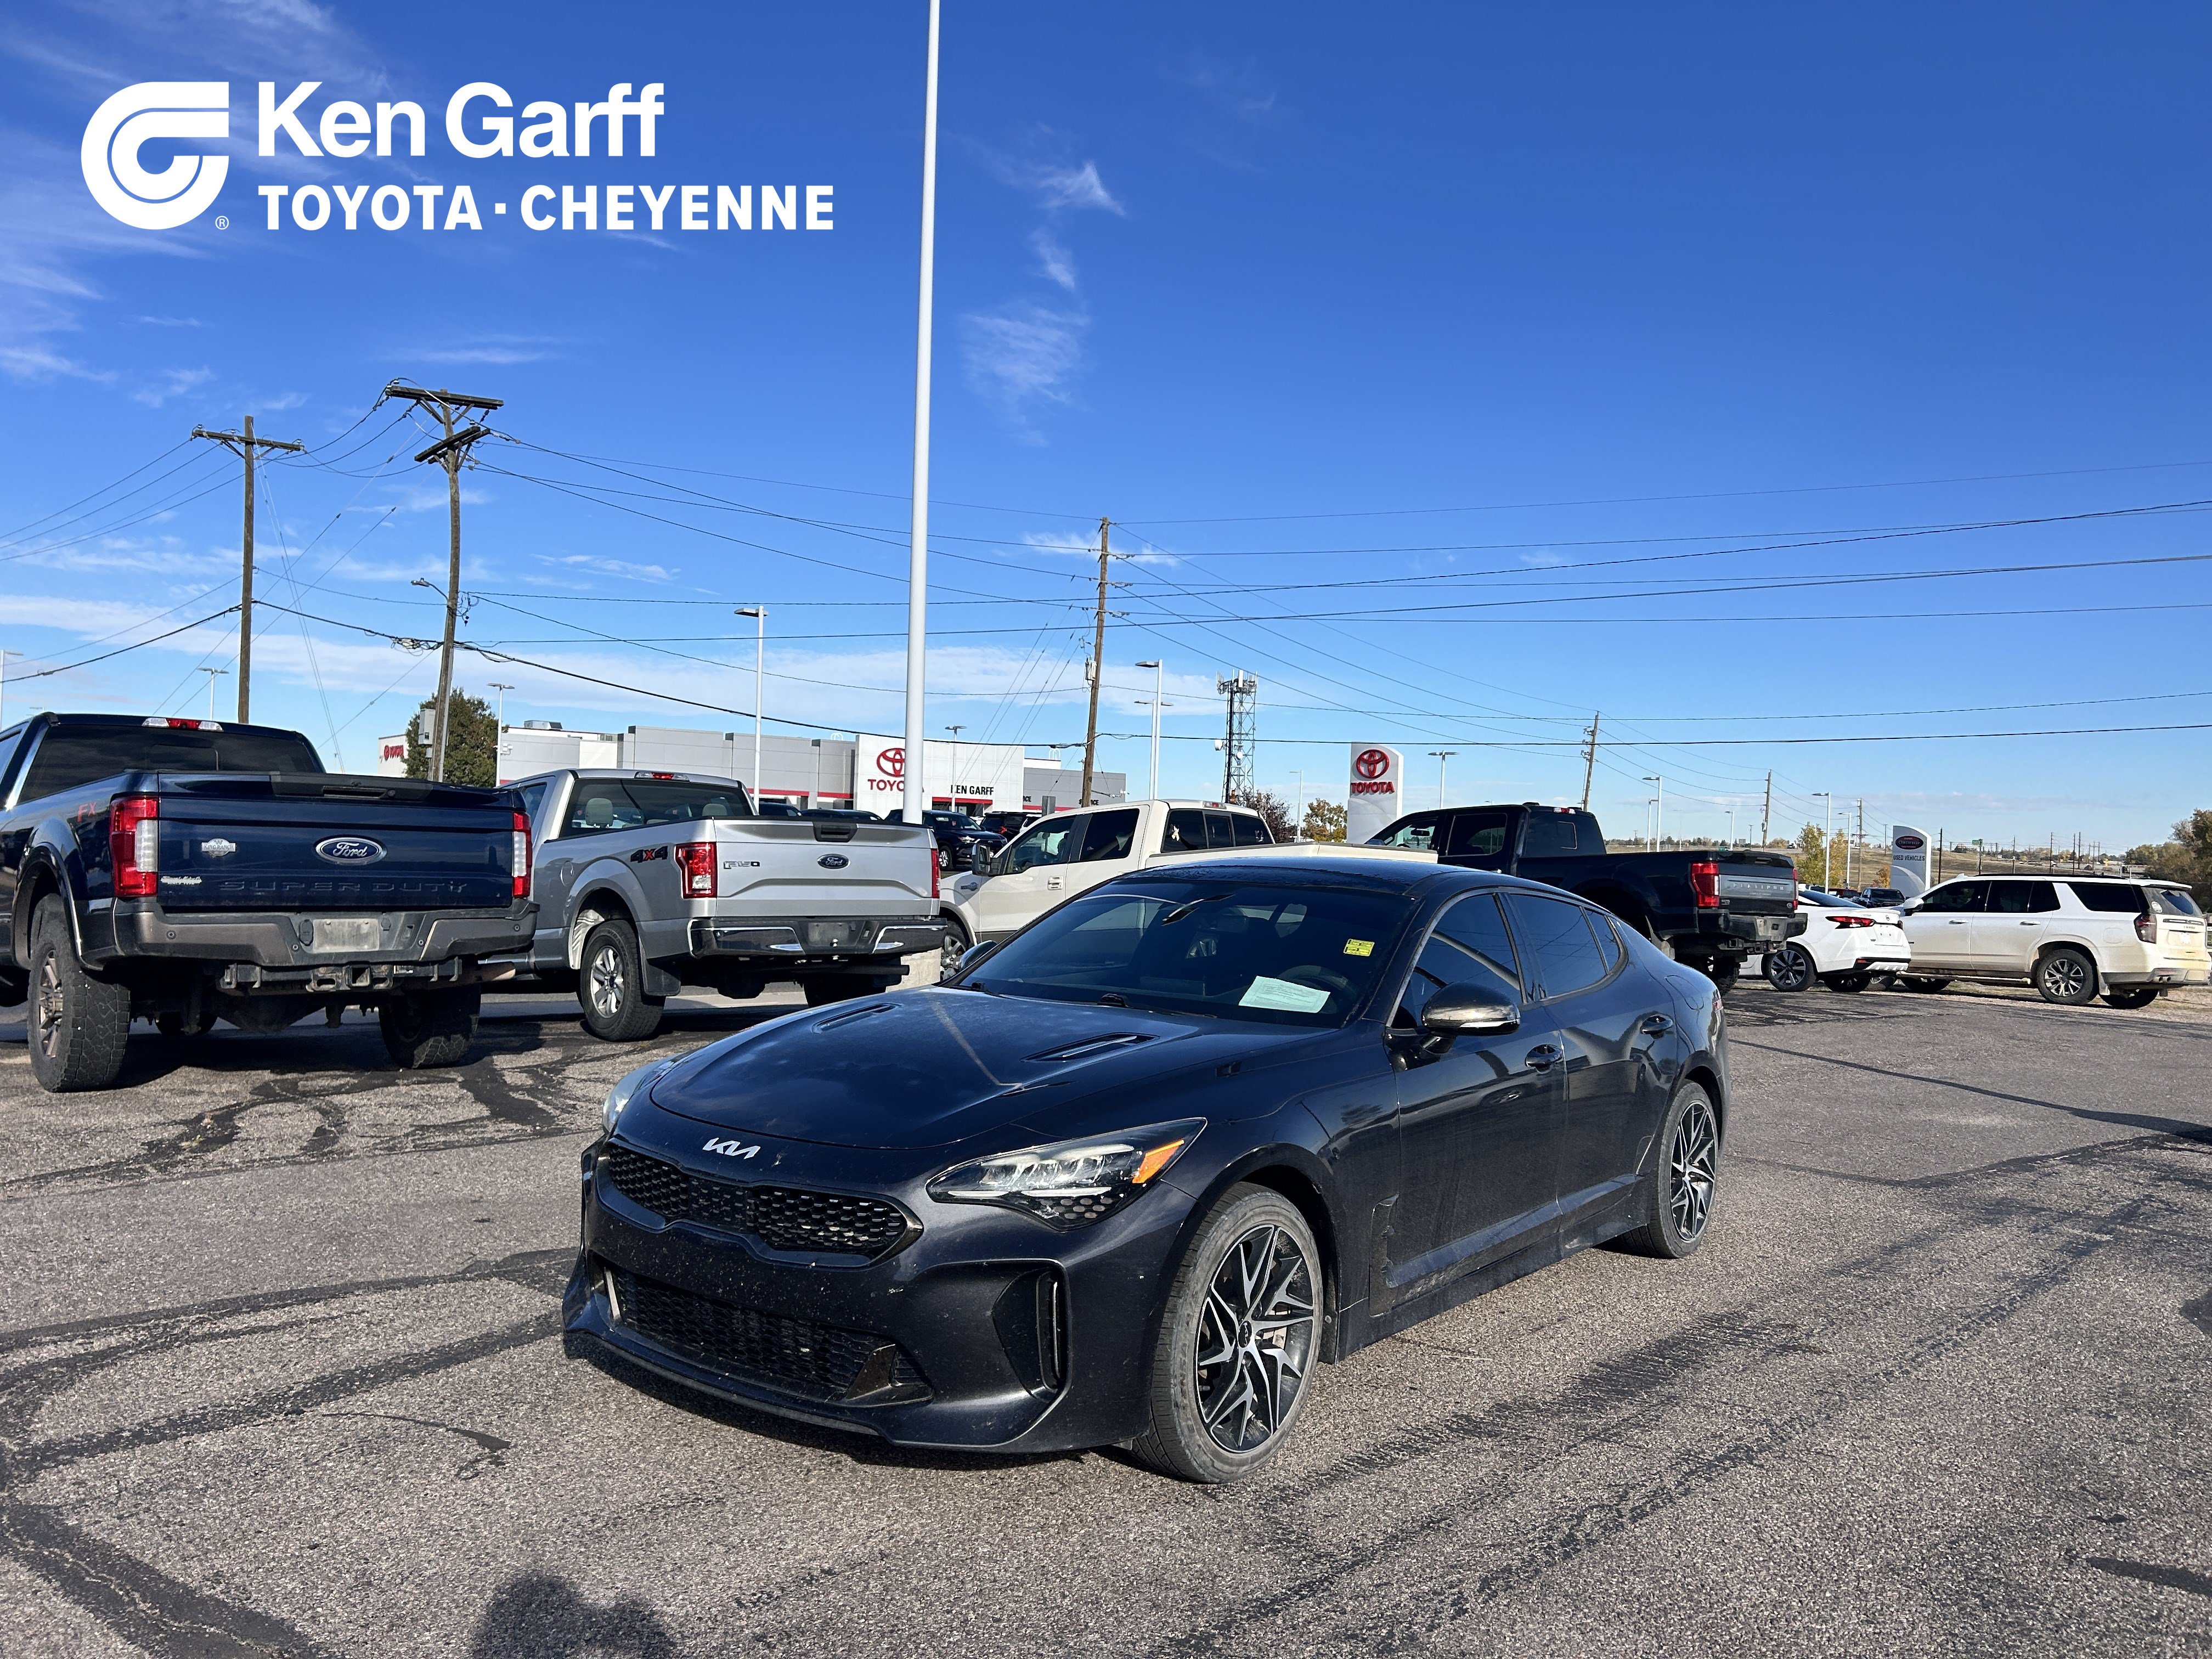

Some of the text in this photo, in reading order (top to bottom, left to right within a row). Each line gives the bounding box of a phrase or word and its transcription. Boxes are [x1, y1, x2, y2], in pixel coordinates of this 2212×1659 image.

[969, 786, 994, 795] GARFF
[1350, 781, 1395, 793] TOYOTA
[332, 842, 368, 857] Ford
[219, 881, 468, 893] SUPER DUTY
[702, 1137, 761, 1160] KIA
